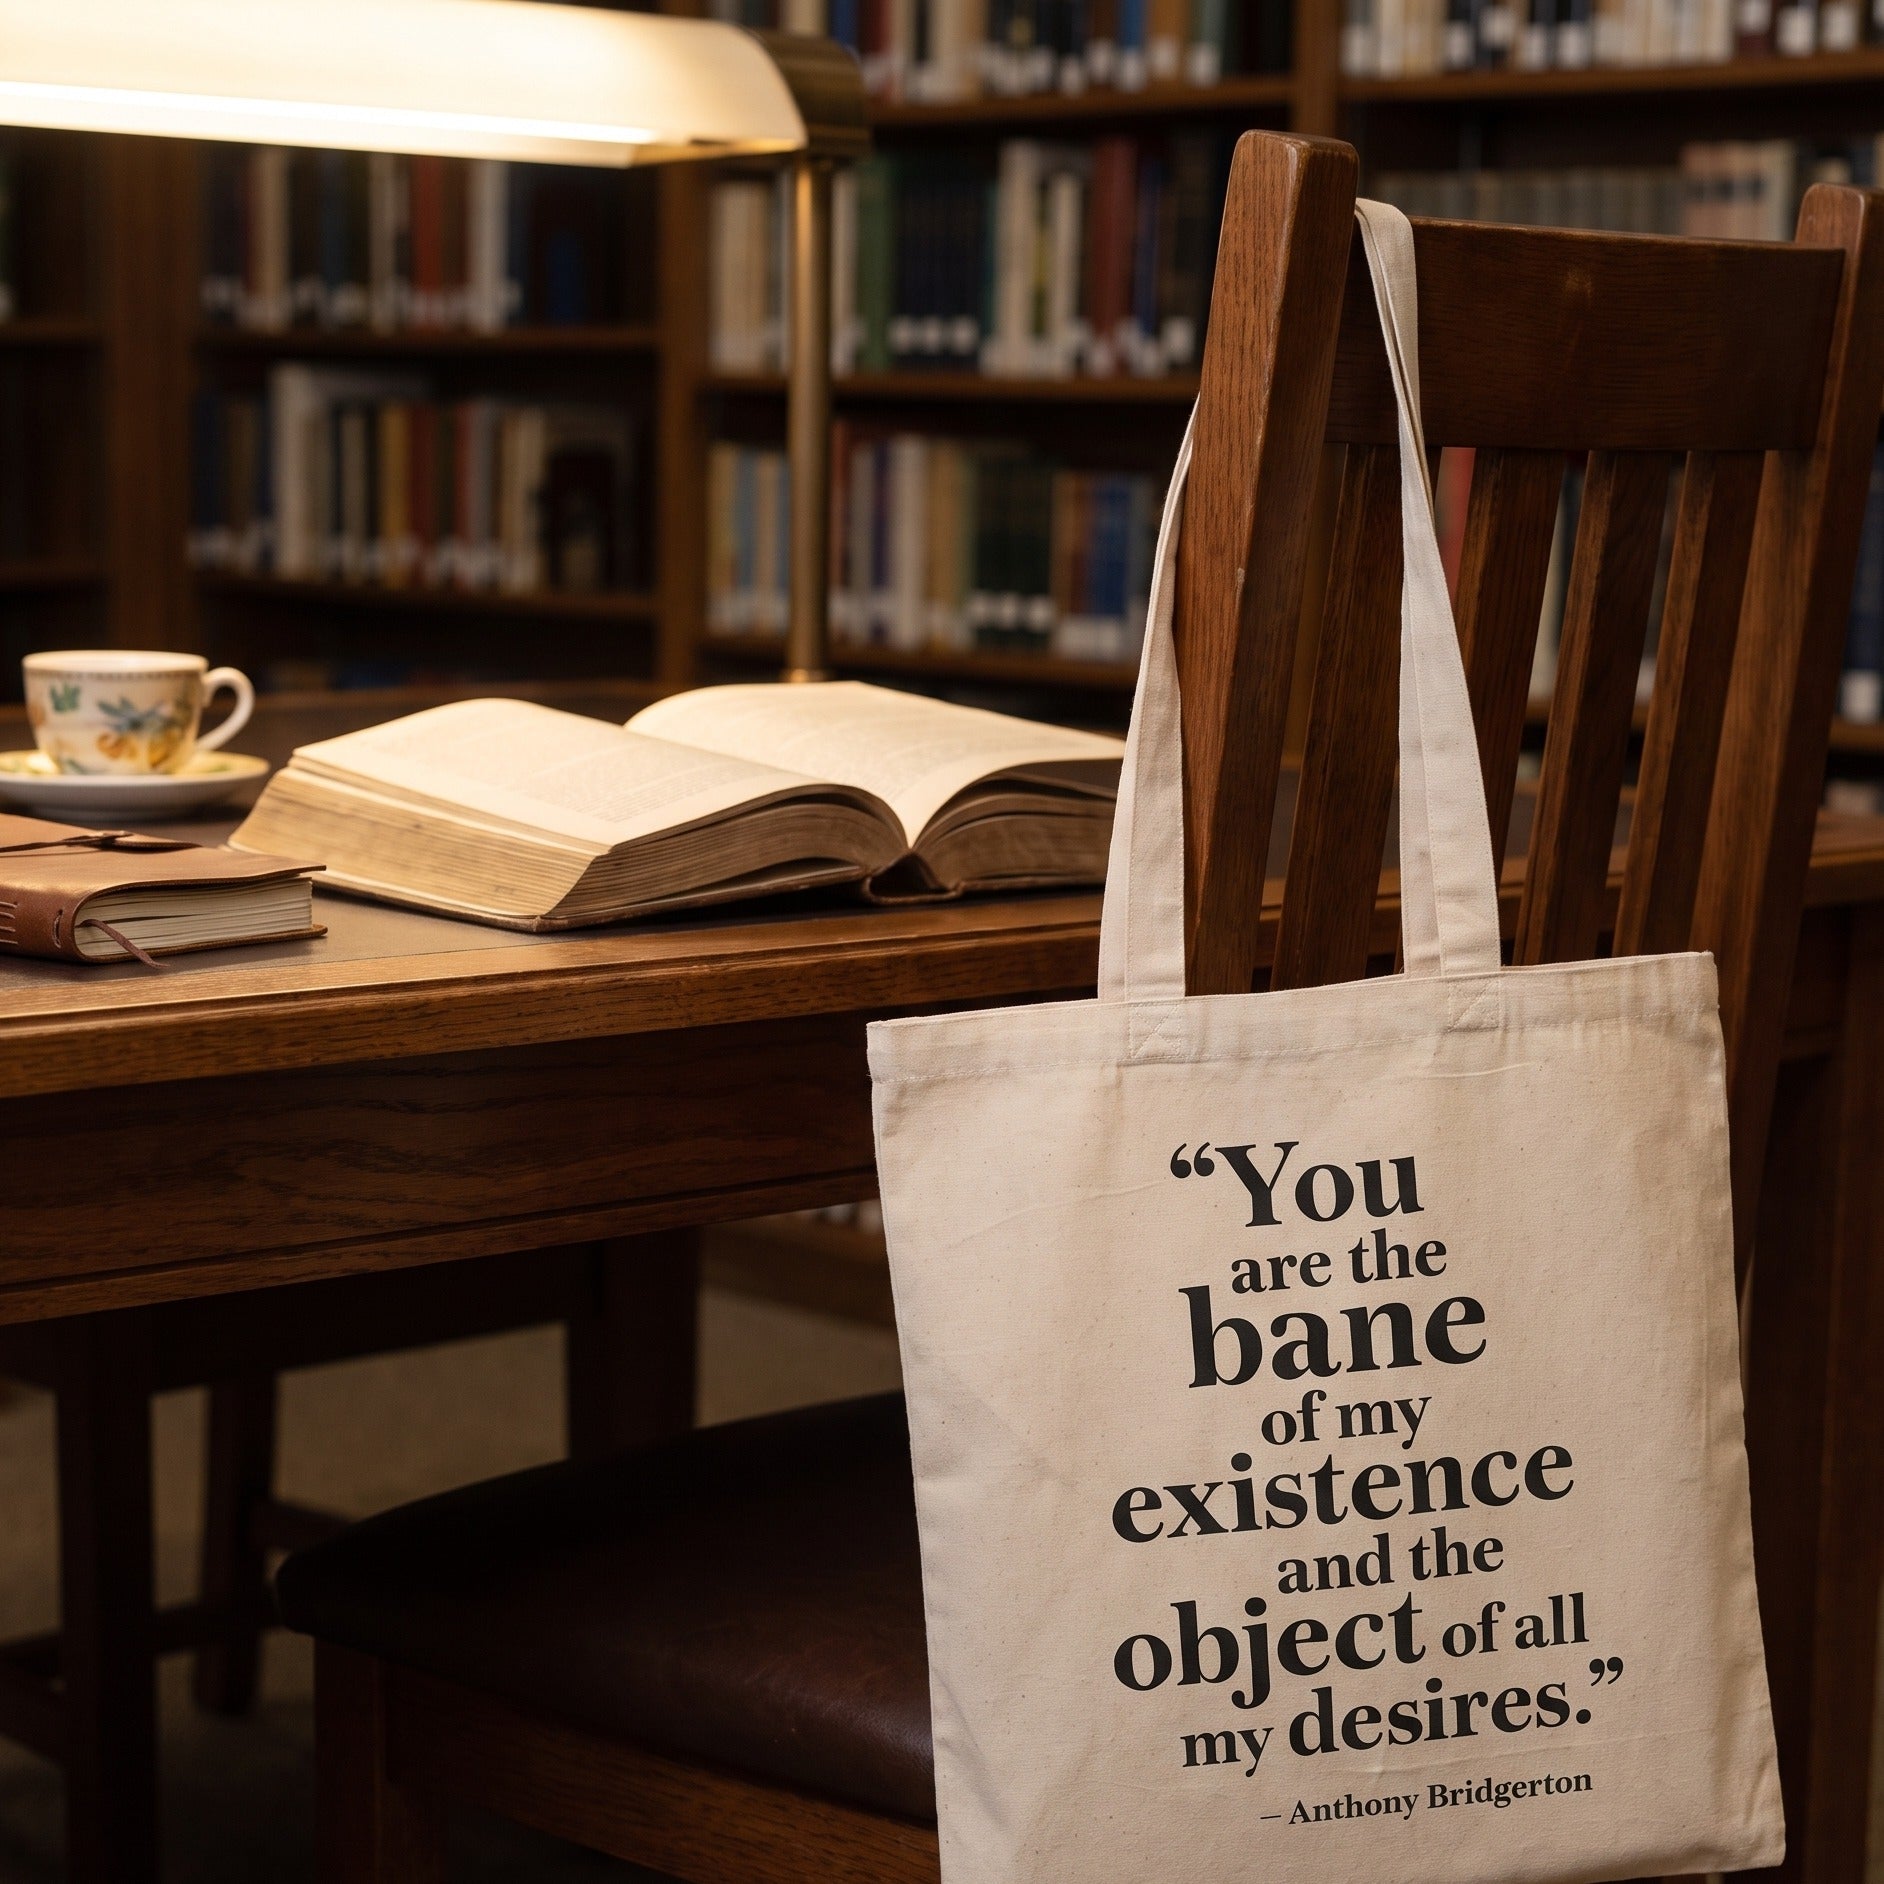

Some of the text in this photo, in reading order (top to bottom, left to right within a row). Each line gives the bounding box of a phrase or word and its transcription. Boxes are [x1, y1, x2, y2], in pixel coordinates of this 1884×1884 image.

[1170, 1142, 1424, 1227] “You
[1231, 1227, 1447, 1295] are the
[1178, 1285, 1487, 1388] bane
[1261, 1389, 1432, 1450] of my
[1112, 1445, 1574, 1544] existence
[1277, 1524, 1504, 1595] and the
[1113, 1591, 1590, 1710] object of all
[1180, 1656, 1624, 1778] my desires.”
[1288, 1787, 1420, 1825] Anthony
[1426, 1773, 1594, 1810] Bridgerton
